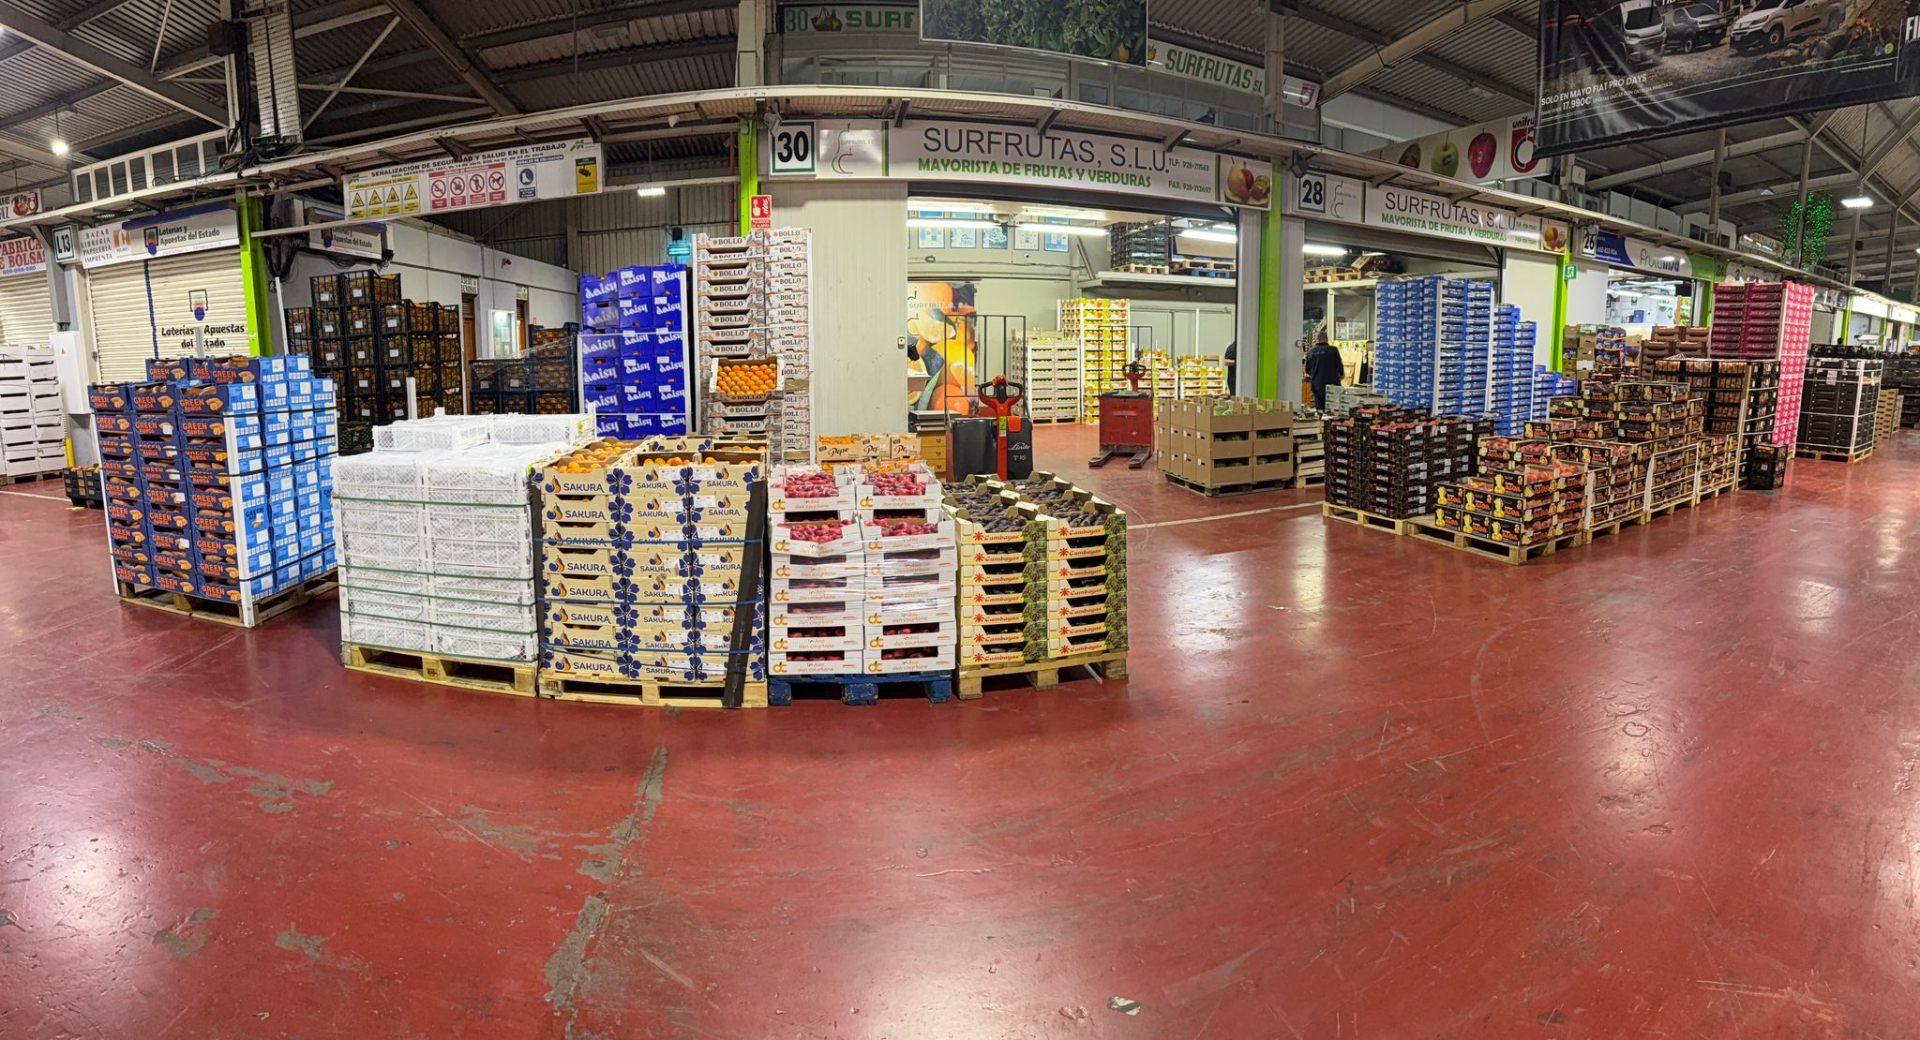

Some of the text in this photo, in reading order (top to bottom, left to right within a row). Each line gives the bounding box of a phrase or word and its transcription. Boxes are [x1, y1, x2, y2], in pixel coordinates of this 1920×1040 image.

[1165, 48, 1253, 90] SURFRUTAS
[1541, 95, 1559, 106] SOLO
[1560, 92, 1569, 101] EN
[1570, 86, 1592, 99] MAYO
[1592, 82, 1608, 93] FIAT
[1609, 78, 1625, 89] PRO
[1625, 73, 1648, 86] DAYS
[777, 130, 809, 163] 30
[923, 127, 1170, 173] SURFRUTAS, S.L.U.
[421, 161, 431, 169] DE
[481, 151, 506, 160] SALUD
[508, 149, 518, 157] EN
[530, 143, 567, 153] TRABAJO
[918, 158, 1151, 188] MAYORISTA DE FRUTAS Y VERDURAS
[1302, 179, 1323, 205] 28
[1381, 212, 1427, 230] MAYORISTA
[1428, 221, 1439, 231] DE
[1440, 223, 1467, 236] FRUTAS
[1468, 228, 1473, 237] Y
[86, 228, 109, 239] BAZAR
[160, 228, 221, 246] Apuestas del Estado
[56, 233, 71, 254] L13
[1583, 232, 1595, 250] 26
[621, 272, 646, 287] daisy
[585, 280, 617, 299] daisy
[623, 303, 648, 317] daisy
[587, 309, 619, 326] daisy
[203, 323, 245, 337] Apuestas
[181, 339, 194, 350] del
[203, 337, 226, 349] tado
[624, 333, 649, 346] daisy
[583, 338, 616, 355] daisy
[150, 368, 170, 376] GREEN
[192, 368, 209, 376] GREE
[625, 361, 650, 374] daisy
[212, 370, 237, 378] GREEN
[584, 367, 617, 383] daisy
[134, 396, 156, 405] GREEN
[627, 390, 652, 401] daisy
[180, 399, 204, 407] GREEN
[183, 422, 207, 430] GREEN
[628, 417, 652, 429] daisy
[106, 484, 125, 493] GREEN
[563, 482, 606, 493] SAKURA
[637, 482, 668, 490] SAKURA
[707, 480, 739, 488] SAKURA
[147, 491, 169, 499] GREEN
[192, 495, 216, 504] GREEN
[108, 506, 128, 515] GREEN
[565, 510, 606, 520] SAKURA
[638, 511, 669, 519] SAKURA
[150, 513, 172, 522] GREEN
[195, 518, 219, 527] GREEN
[152, 535, 174, 544] GREEN
[197, 540, 221, 550] GREEN
[114, 548, 132, 558] GREEN
[200, 563, 224, 574] GREEN
[567, 562, 608, 573] SAKURA
[640, 565, 671, 573] SAKURA
[711, 563, 742, 571] SAKURA
[157, 577, 178, 586] GREEN
[202, 586, 225, 596] GREEN
[569, 587, 610, 599] SAKURA
[571, 613, 611, 624] SAKURA
[645, 642, 676, 650] SAKURA
[573, 662, 613, 673] SAKURA
[646, 667, 676, 675] SAKURA
